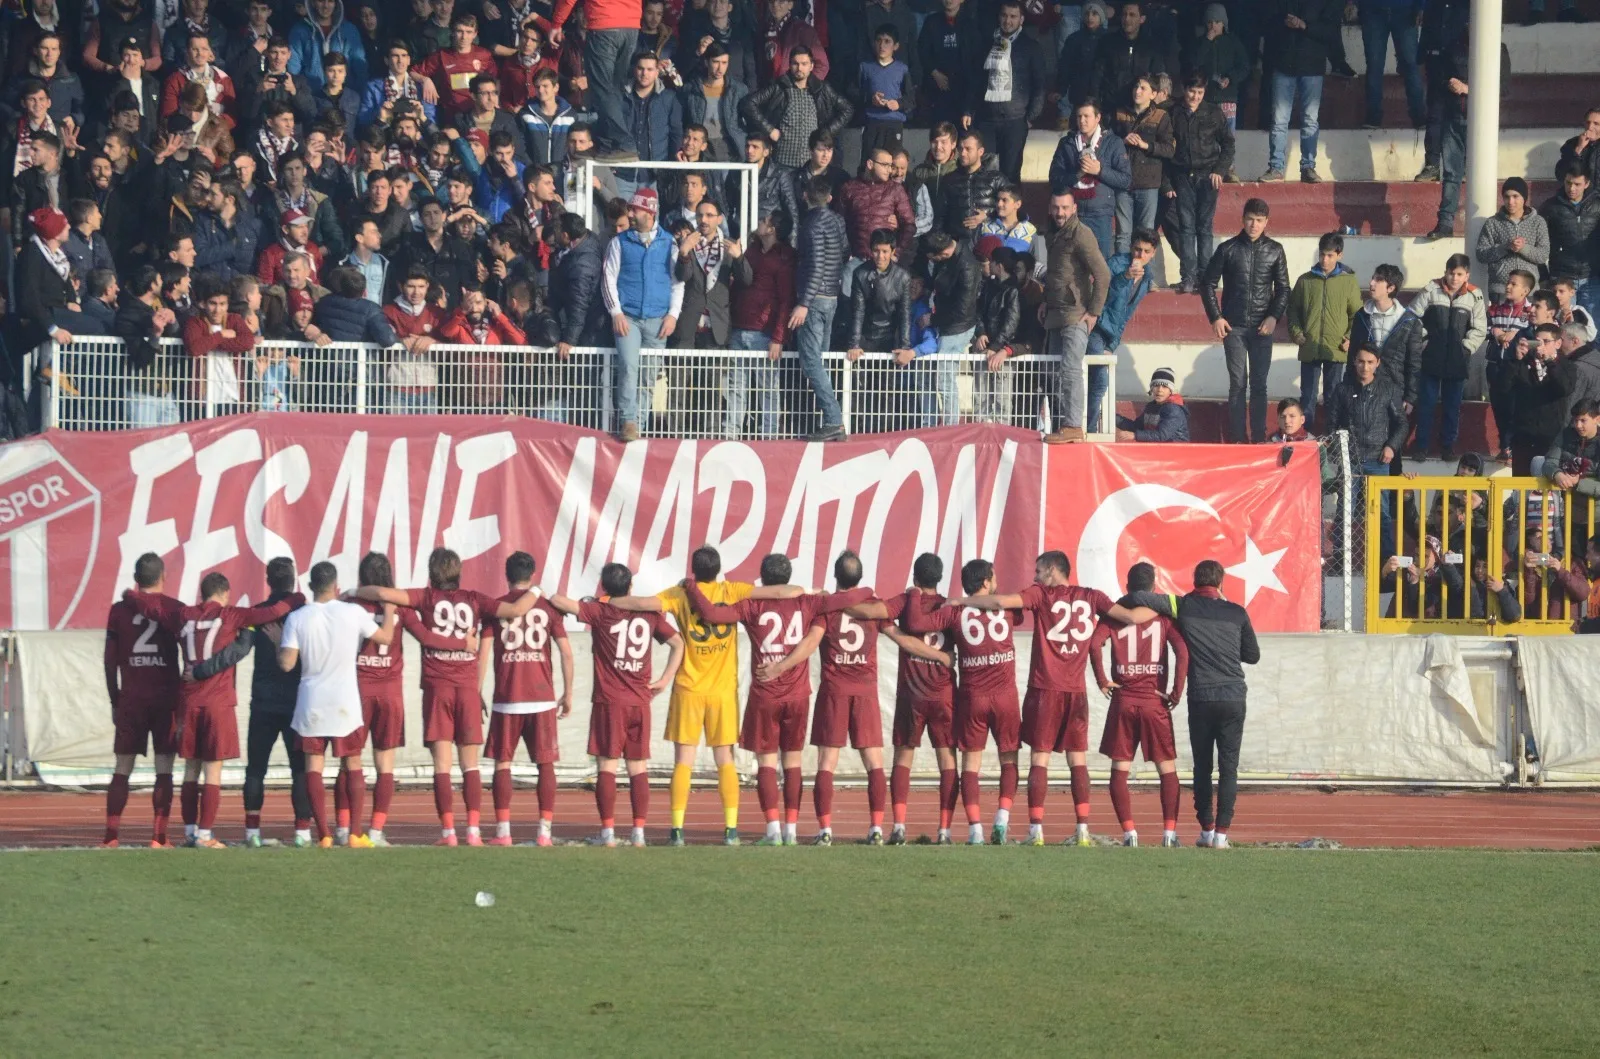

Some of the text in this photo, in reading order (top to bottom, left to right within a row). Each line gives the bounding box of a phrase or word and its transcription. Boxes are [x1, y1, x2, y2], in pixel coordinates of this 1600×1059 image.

[0, 475, 71, 523] SPOR
[131, 613, 159, 653] 2
[180, 617, 223, 661] 17
[433, 600, 474, 638] 99
[500, 608, 549, 650] 88
[610, 618, 650, 659] 19
[758, 611, 804, 653] 24
[838, 611, 866, 652] 5
[960, 607, 1010, 646] 68
[1046, 600, 1095, 642] 23
[835, 652, 867, 665] BİLAL
[962, 655, 988, 667] HAKAN
[1060, 644, 1079, 655] A.A
[1117, 621, 1162, 663] 11
[614, 658, 643, 672] RAİF
[1116, 663, 1164, 677] M.ŞEKER
